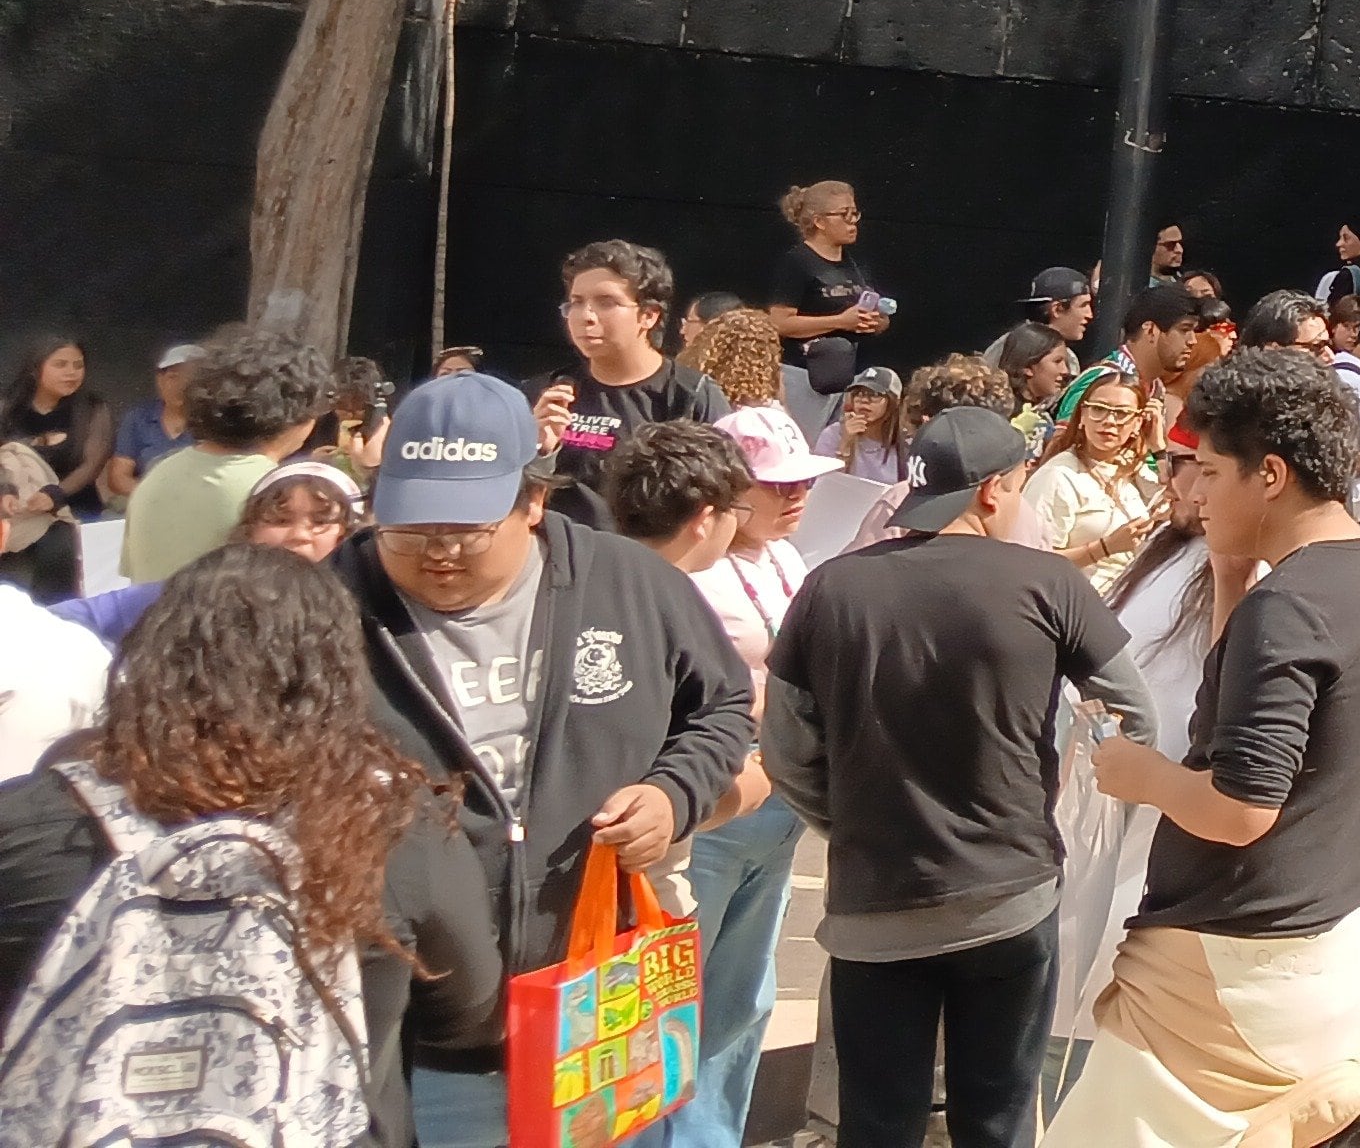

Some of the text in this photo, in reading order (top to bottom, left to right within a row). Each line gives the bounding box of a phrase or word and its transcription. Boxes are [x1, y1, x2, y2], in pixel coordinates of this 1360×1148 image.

[570, 412, 622, 429] OLIVER
[572, 423, 610, 436] TREE
[402, 436, 498, 461] adidas
[644, 938, 696, 984] BIG
